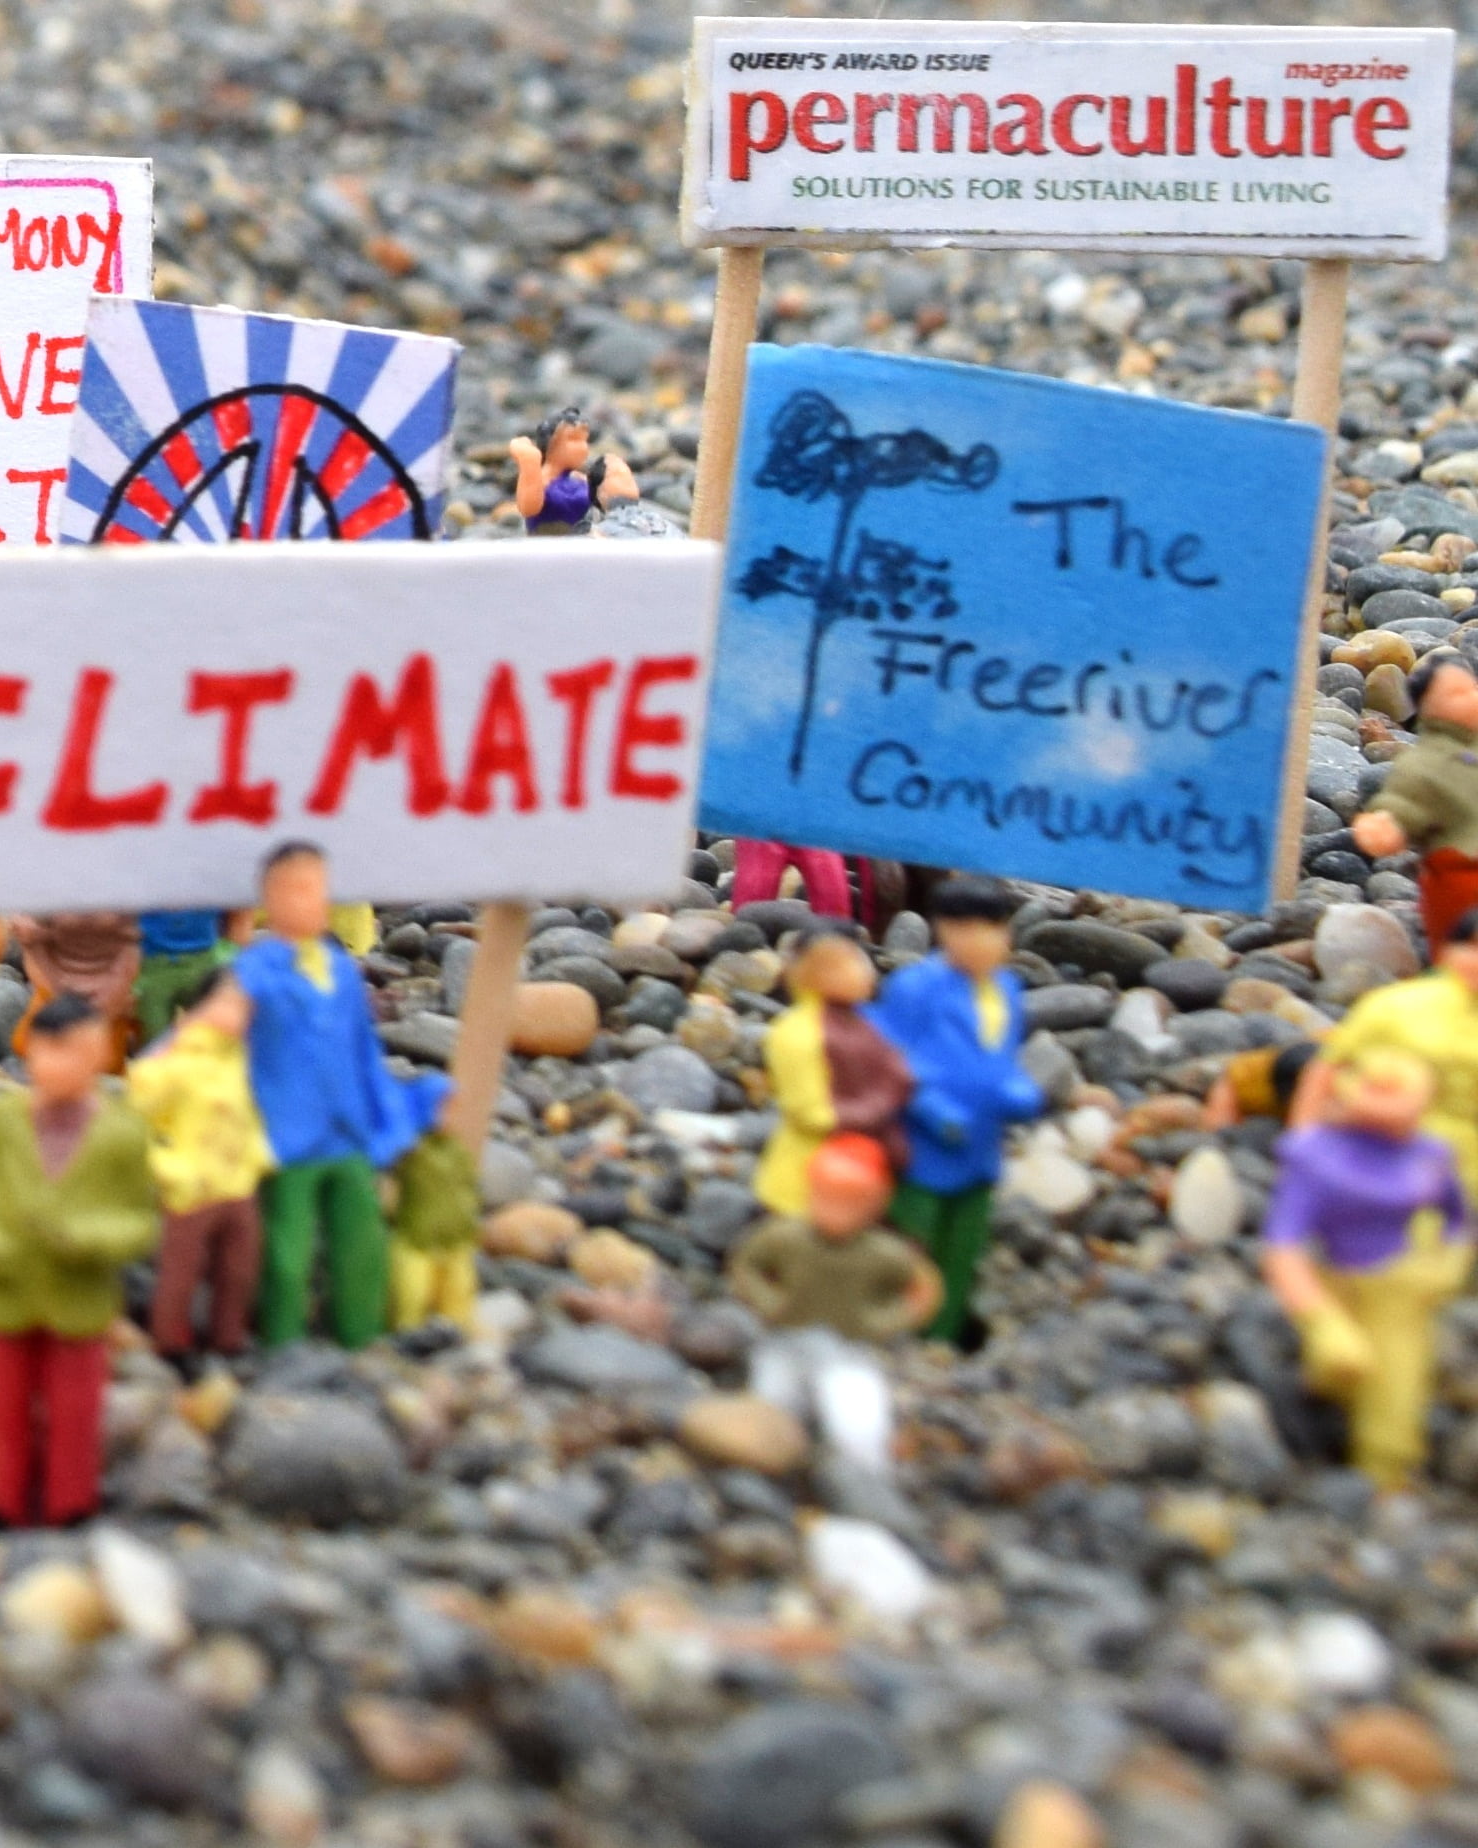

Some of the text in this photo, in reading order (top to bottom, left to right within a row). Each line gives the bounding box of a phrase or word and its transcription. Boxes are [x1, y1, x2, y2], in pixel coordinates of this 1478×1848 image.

[729, 52, 990, 71] QUEEN'S AWARD ISSUE
[1284, 57, 1410, 86] magazine
[728, 63, 1410, 181] permaculture
[792, 176, 1332, 203] SOLUTIONS FOR SUSTAINABLE LIVING
[1012, 497, 1218, 587] The
[872, 629, 1280, 737] Freeriver
[848, 742, 1263, 888] Community
